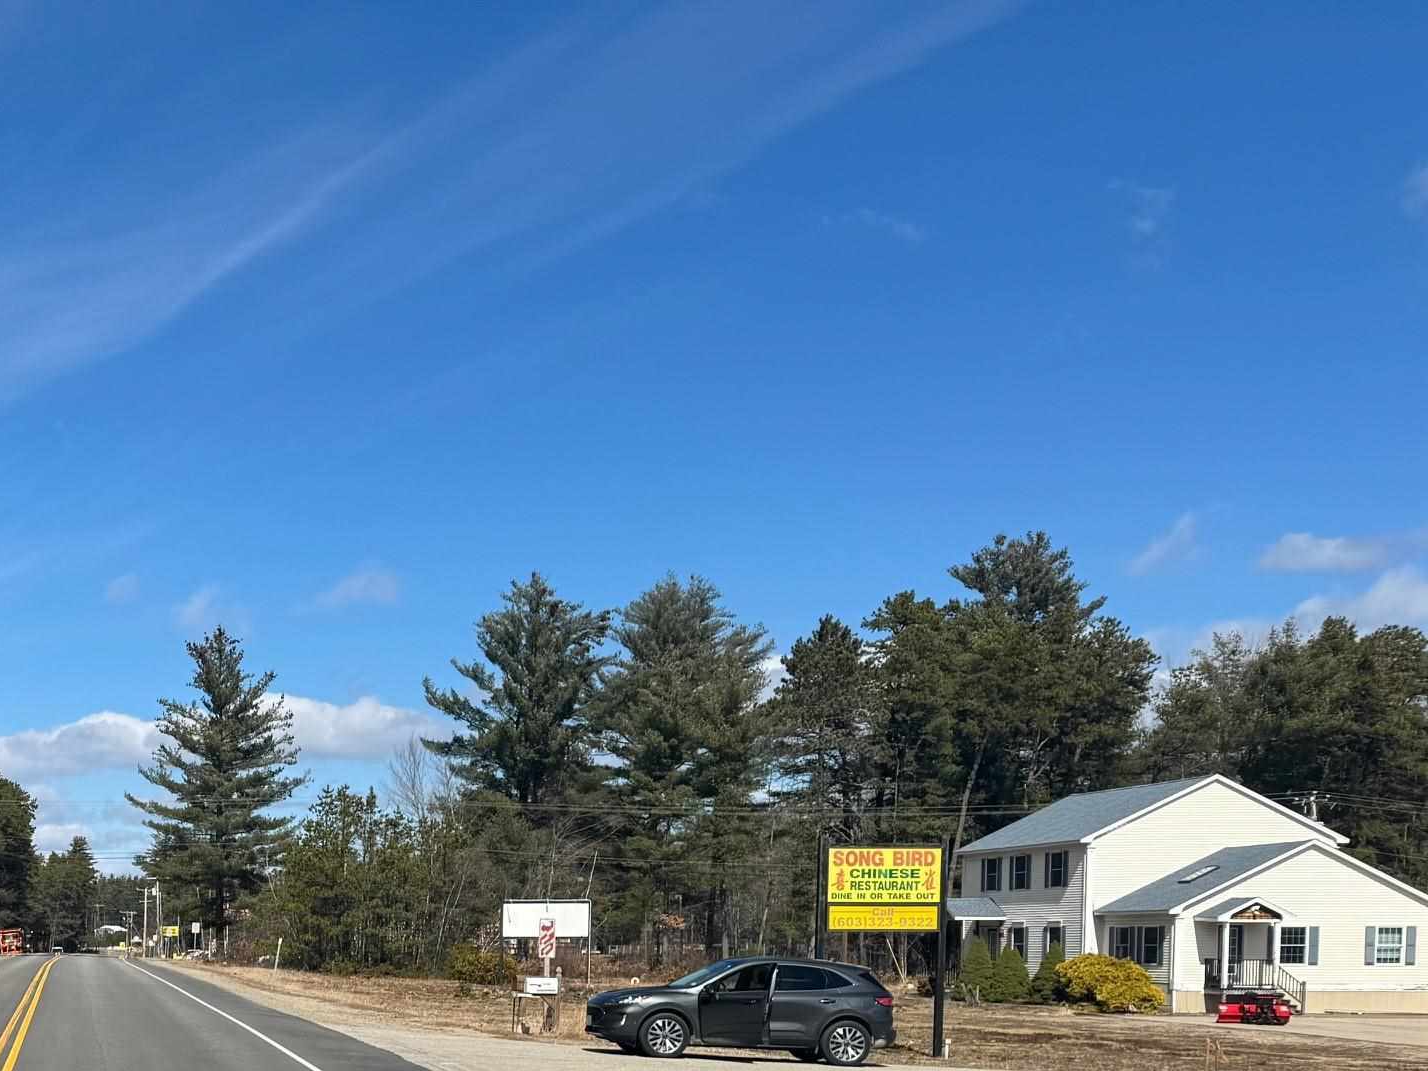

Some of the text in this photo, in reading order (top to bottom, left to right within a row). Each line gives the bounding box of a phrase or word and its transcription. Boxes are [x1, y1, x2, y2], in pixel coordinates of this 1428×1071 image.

[833, 851, 935, 867] SONG BIRD
[849, 868, 920, 879] CHINESE
[850, 880, 920, 891] RESTAURANT
[916, 892, 935, 900] OUT
[872, 908, 894, 917] Call
